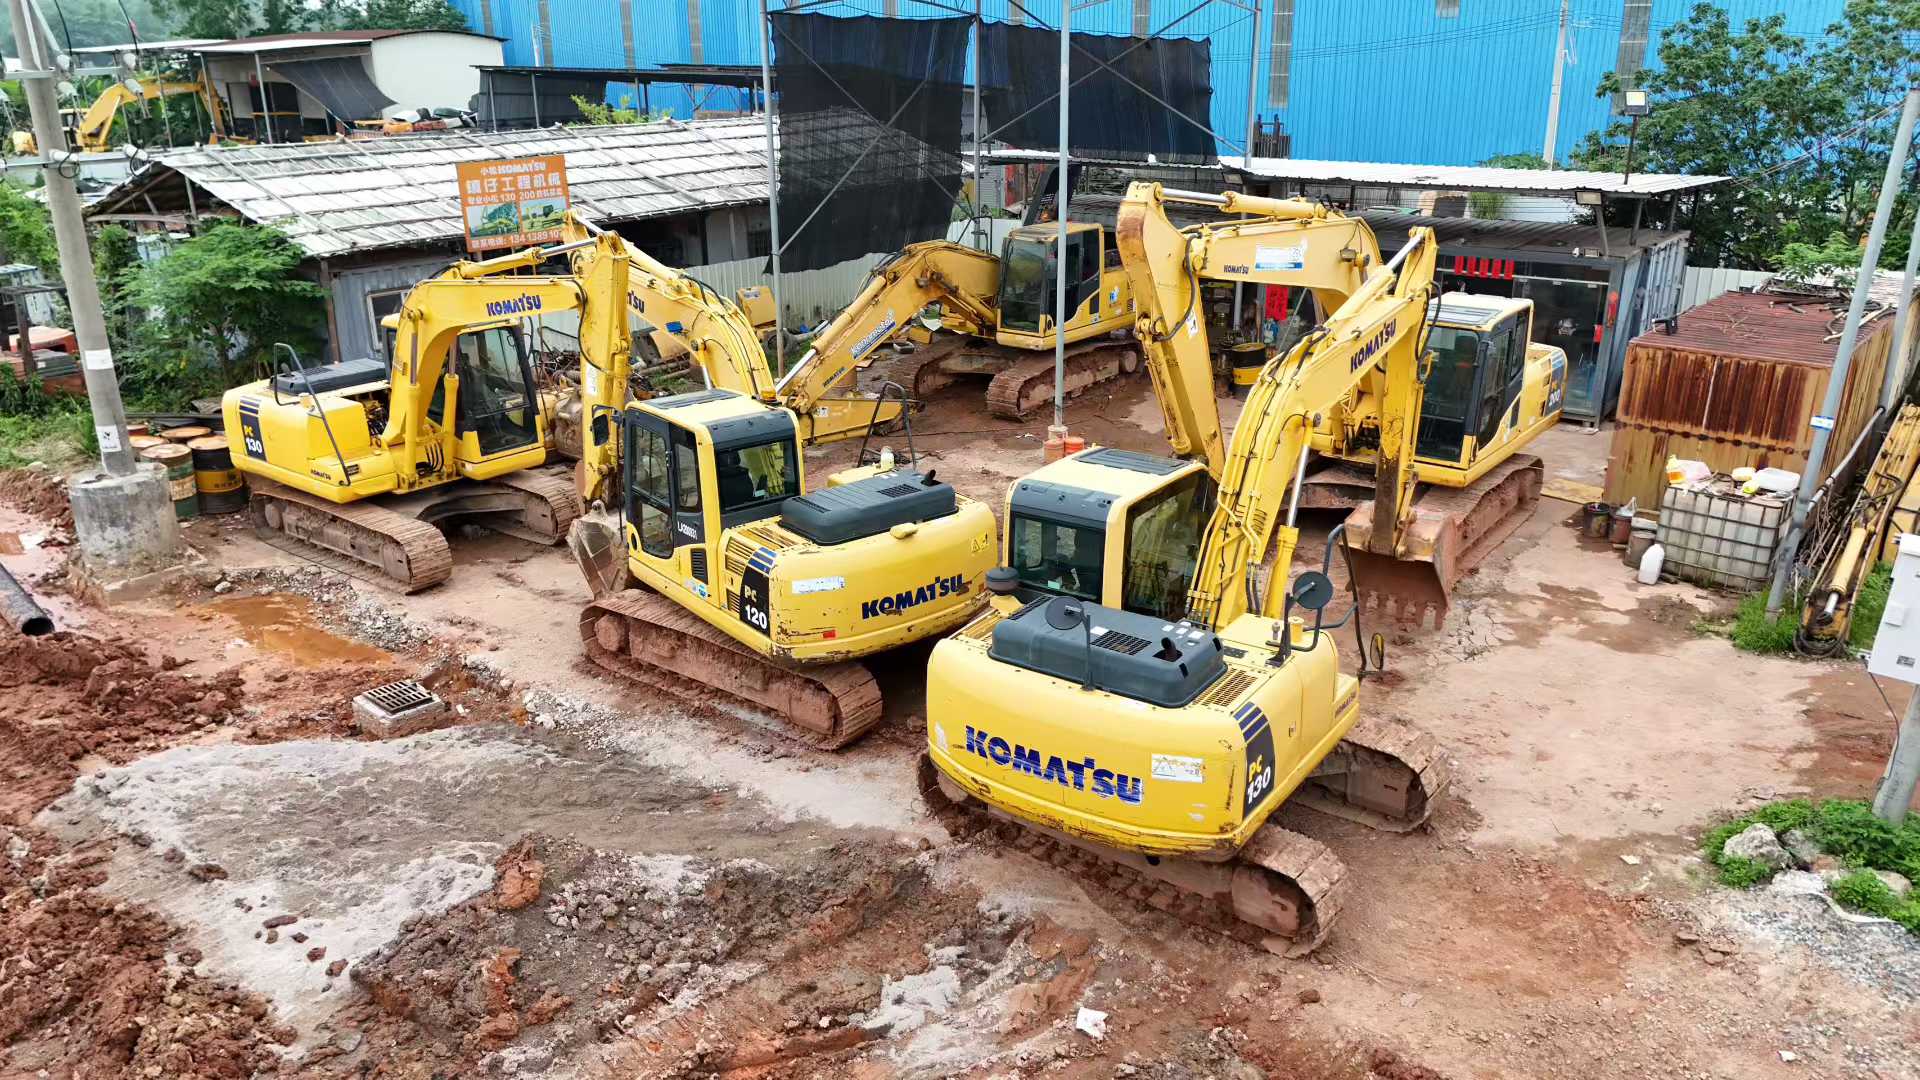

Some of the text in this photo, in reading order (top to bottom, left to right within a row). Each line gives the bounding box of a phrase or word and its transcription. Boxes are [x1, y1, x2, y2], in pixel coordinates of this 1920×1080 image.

[1223, 264, 1249, 275] KOMATSU
[486, 293, 542, 316] KOMATSU
[1350, 318, 1396, 374] KOMATSU
[246, 437, 263, 453] 130
[744, 585, 757, 602] PC
[861, 573, 965, 619] KOMATSU
[745, 604, 768, 630] 120
[965, 725, 1143, 805] KOMATSU
[1249, 754, 1263, 780] PC
[1248, 765, 1271, 804] 130
